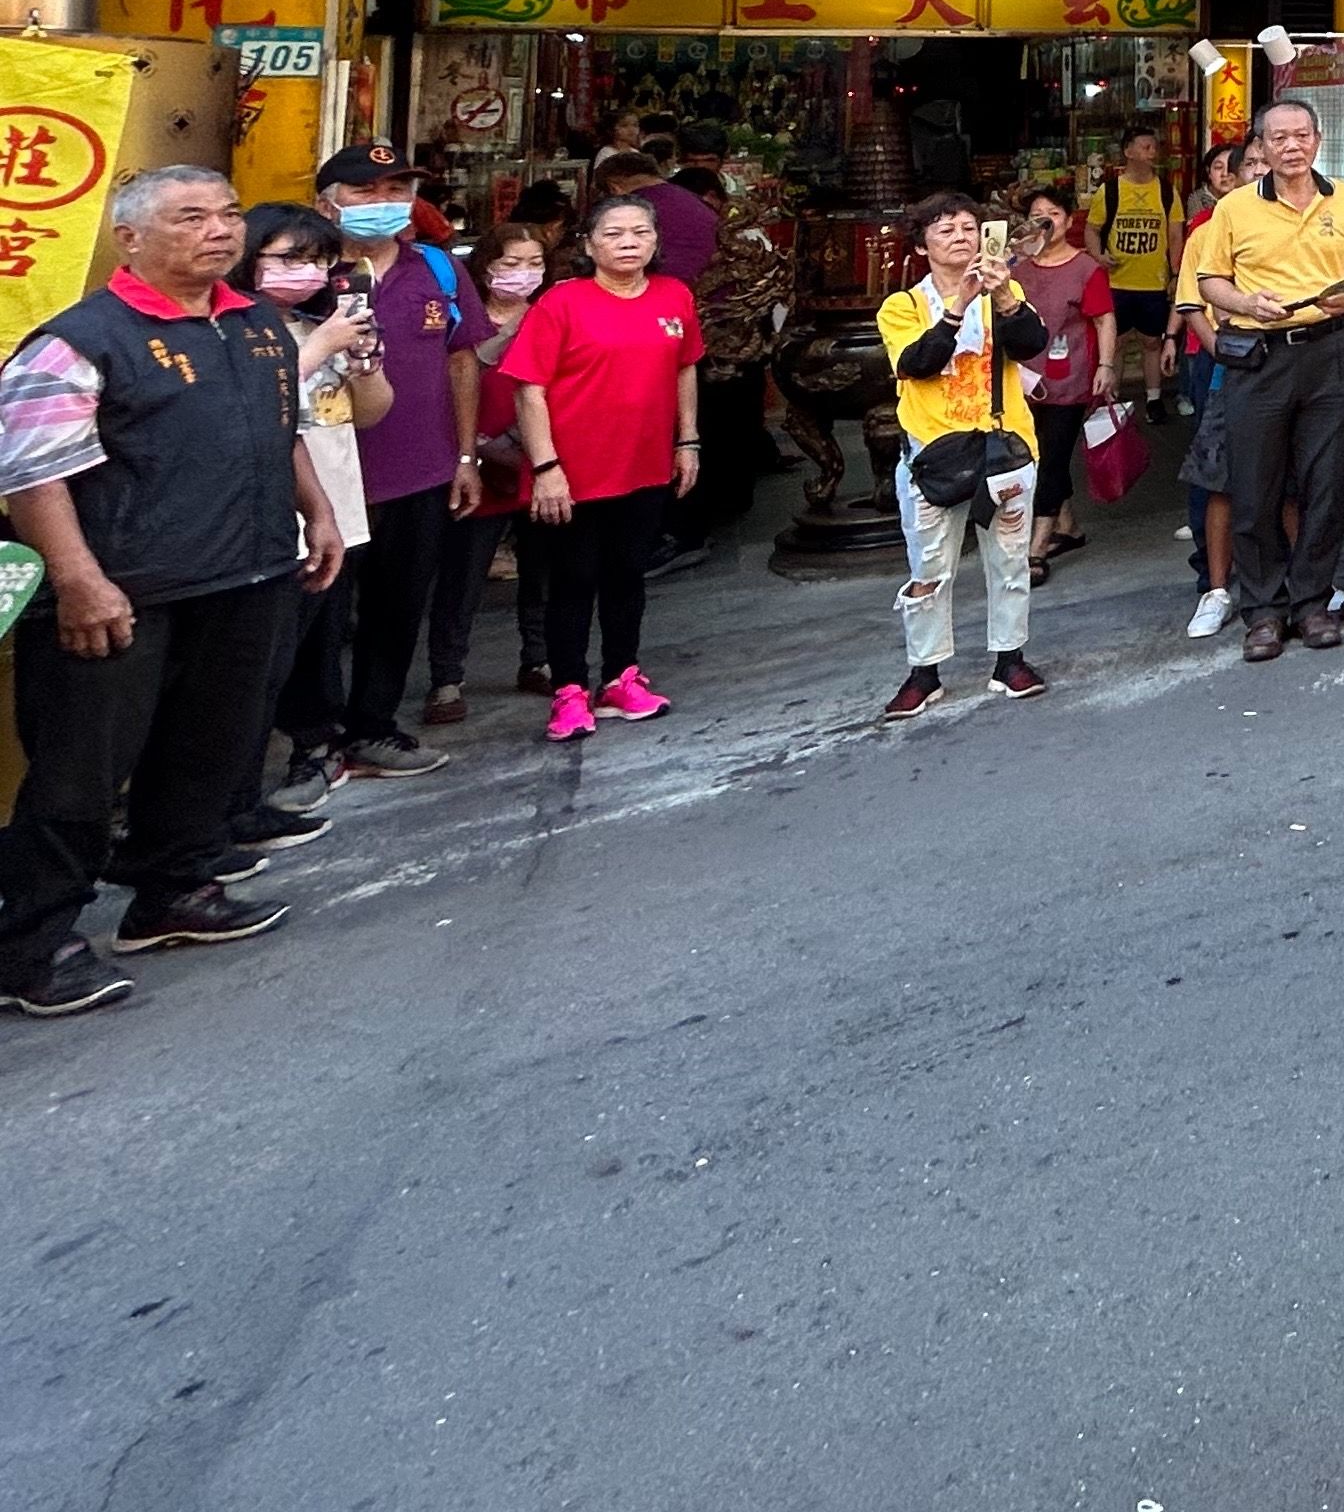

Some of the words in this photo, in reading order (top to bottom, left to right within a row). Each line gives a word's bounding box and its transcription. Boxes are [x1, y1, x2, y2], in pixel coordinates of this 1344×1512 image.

[249, 44, 315, 77] 105
[1116, 218, 1161, 229] FOREVER
[1116, 231, 1158, 254] HERO
